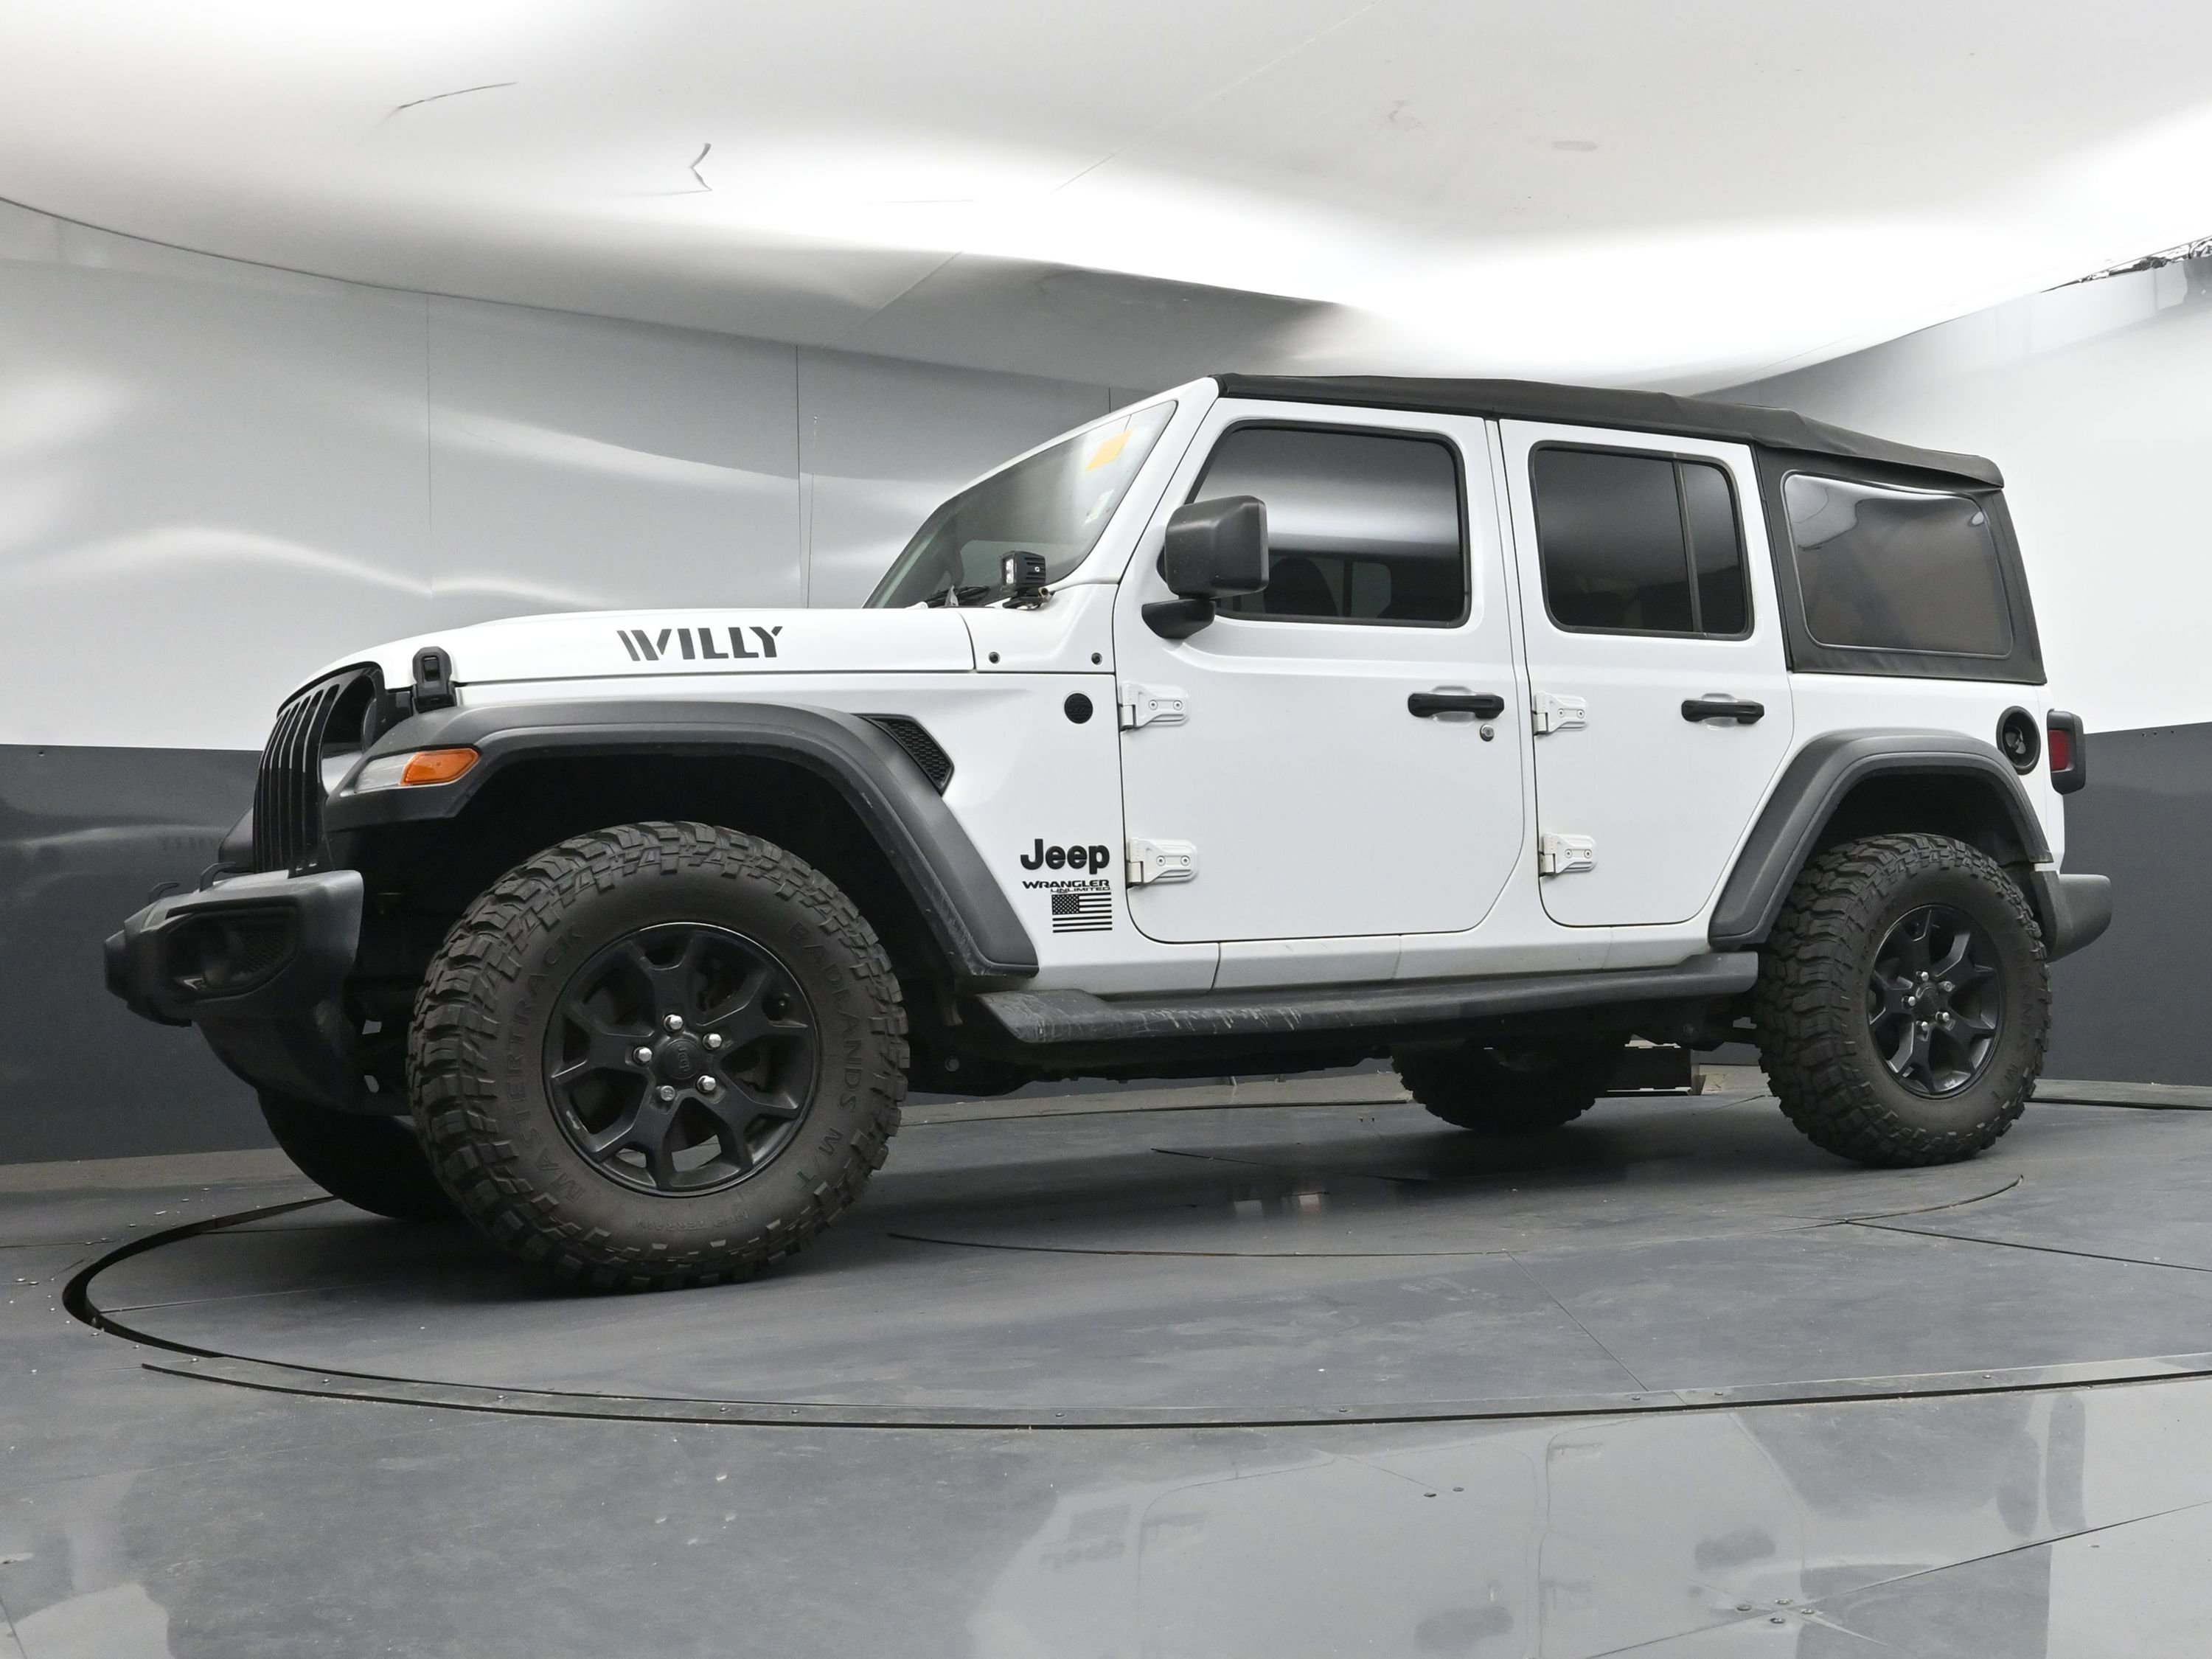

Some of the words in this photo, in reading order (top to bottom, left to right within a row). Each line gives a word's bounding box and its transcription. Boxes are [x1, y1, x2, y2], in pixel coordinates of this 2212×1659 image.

[616, 626, 783, 661] WILLY
[1020, 838, 1110, 874] Jeep
[1022, 879, 1110, 889] WRANGLER
[787, 920, 863, 1113] BADLANDS
[505, 923, 585, 1203] MASTERTRACK
